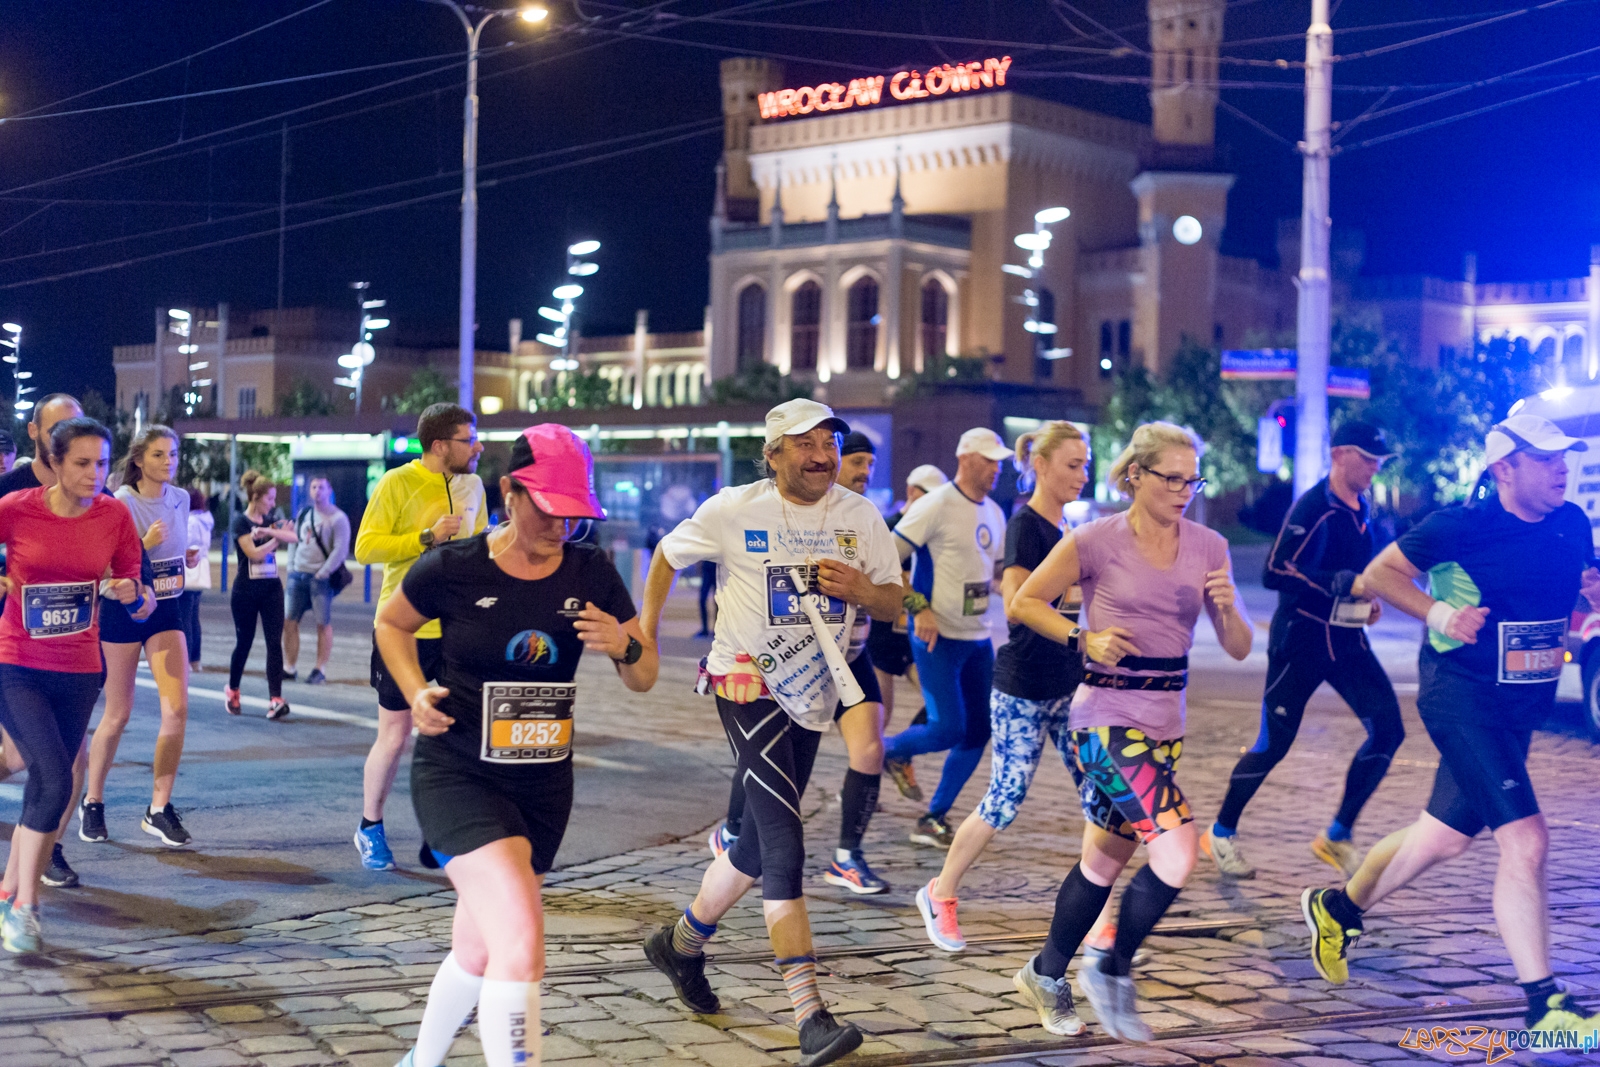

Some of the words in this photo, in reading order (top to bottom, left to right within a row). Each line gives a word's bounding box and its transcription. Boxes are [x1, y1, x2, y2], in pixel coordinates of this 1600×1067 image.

[757, 75, 885, 119] WROCŁAW
[890, 56, 1012, 100] GŁÓWNY
[475, 596, 498, 609] 4F
[787, 594, 830, 613] 329
[42, 608, 79, 626] 9637
[766, 634, 786, 650] lat
[510, 722, 562, 745] 8252
